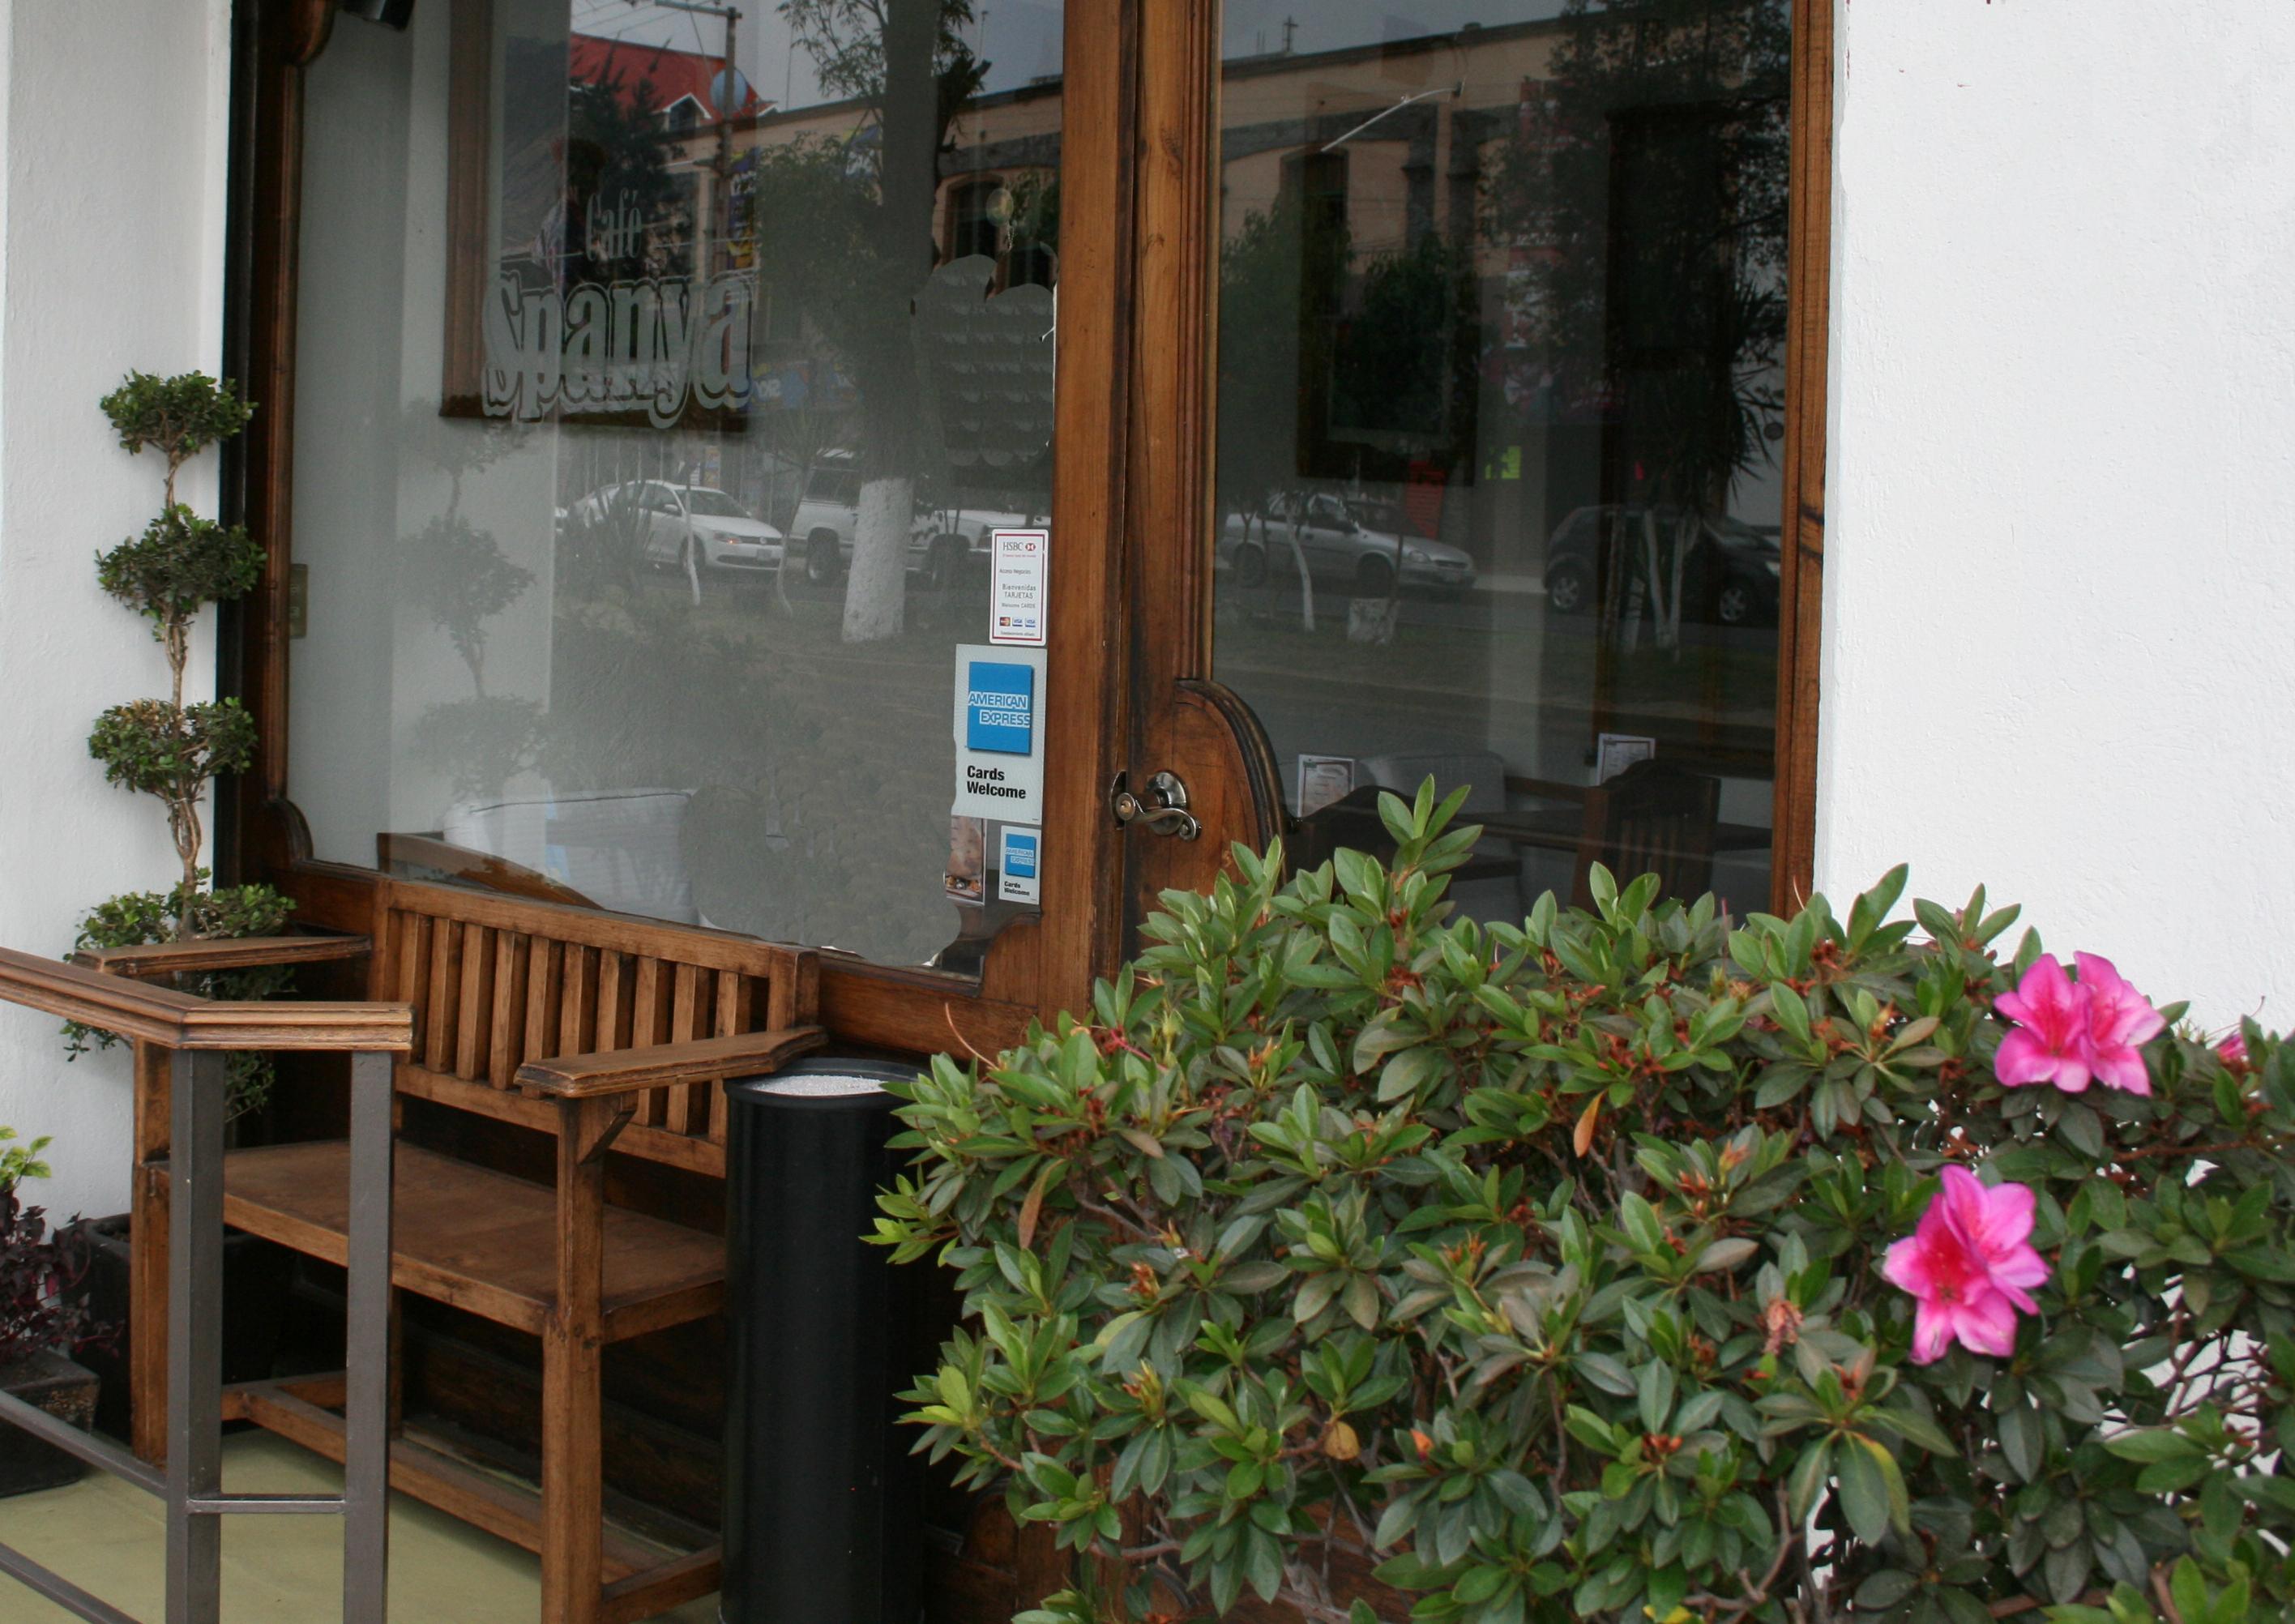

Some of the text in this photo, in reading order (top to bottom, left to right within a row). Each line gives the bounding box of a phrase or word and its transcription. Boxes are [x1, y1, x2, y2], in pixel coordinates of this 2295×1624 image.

[585, 187, 643, 261] Café
[481, 270, 753, 430] Spanya
[1003, 542, 1024, 551] HSBC
[968, 693, 1027, 708] AMERICAN
[980, 712, 1031, 726] EXPRESS
[967, 765, 1005, 780] Cards
[967, 780, 1026, 799] Welcome
[1004, 887, 1030, 895] Welcome
